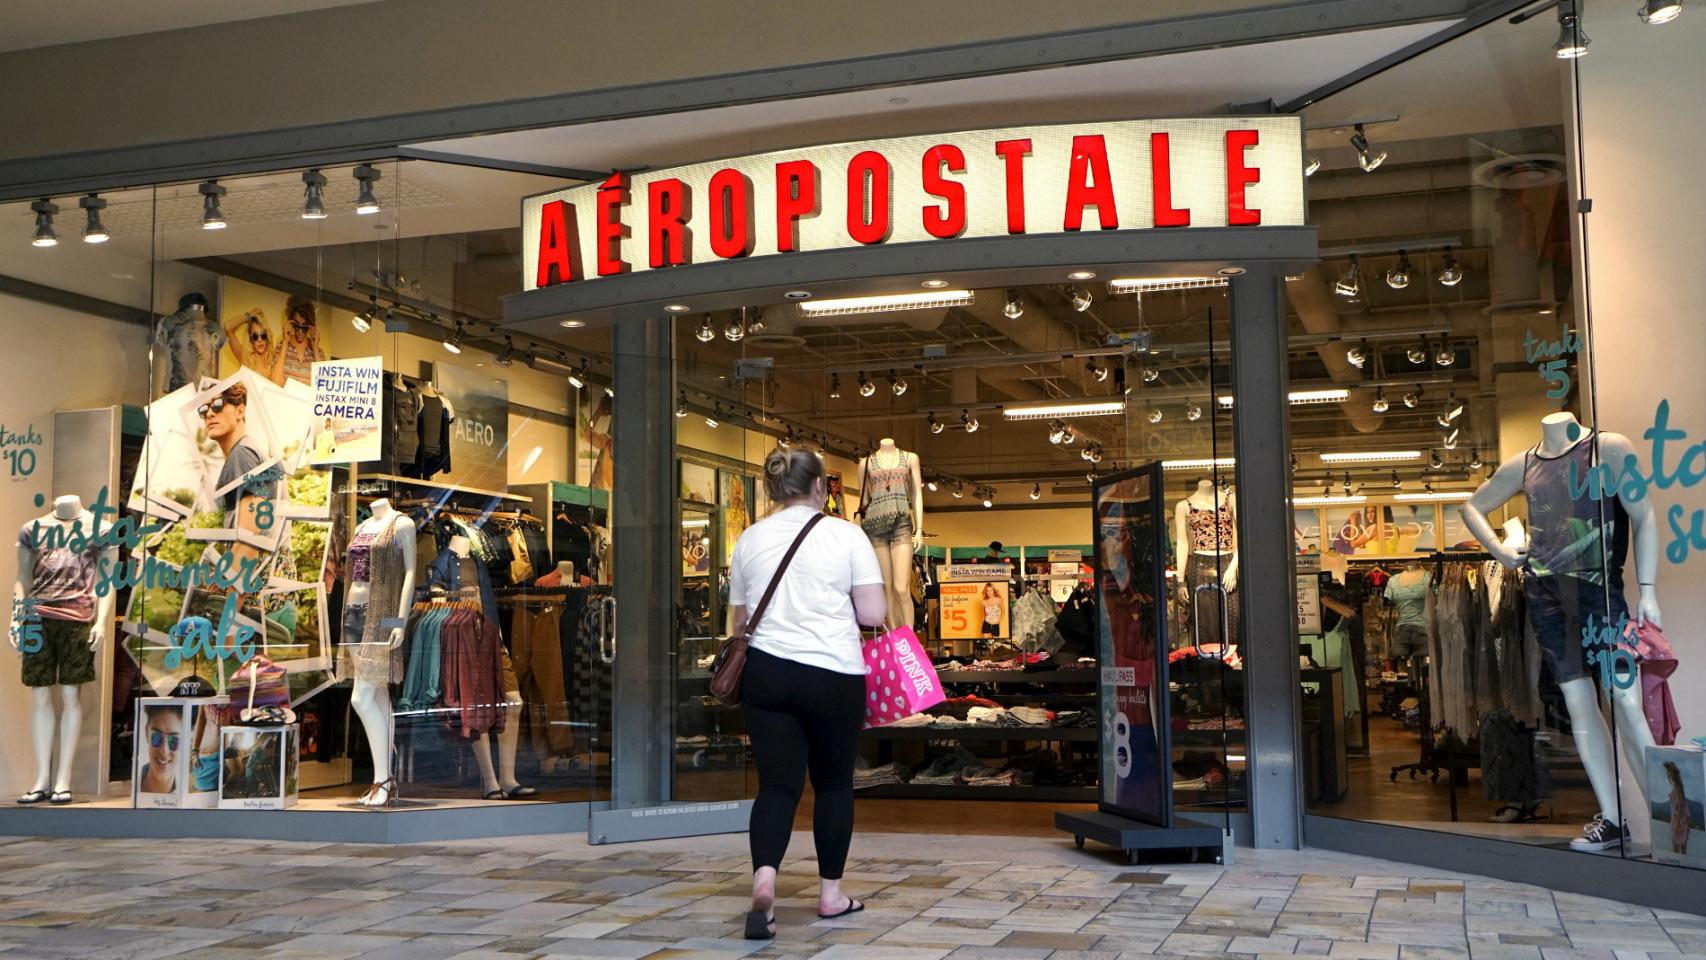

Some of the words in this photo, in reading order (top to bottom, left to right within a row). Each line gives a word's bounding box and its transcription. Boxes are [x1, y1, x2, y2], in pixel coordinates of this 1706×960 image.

[536, 129, 1261, 288] AÉROPOSTALE
[1523, 323, 1585, 363] tanks
[317, 379, 378, 395] FUJIFILM
[318, 366, 352, 378] INSTA
[355, 367, 379, 379] WIN
[1538, 359, 1570, 399] $5
[313, 403, 375, 420] CAMERA
[315, 394, 347, 404] INSTAX
[349, 396, 369, 405] MINI
[370, 397, 377, 406] 8
[0, 423, 43, 448] tanks
[455, 417, 494, 447] AERO
[2, 448, 37, 477] $10
[247, 500, 275, 530] $8
[95, 551, 263, 598] summer
[164, 591, 256, 669] sale
[943, 609, 968, 632] $5
[893, 637, 934, 698] PINK
[1119, 670, 1134, 683] PASS
[1586, 649, 1637, 690] $10
[180, 682, 201, 695] NY
